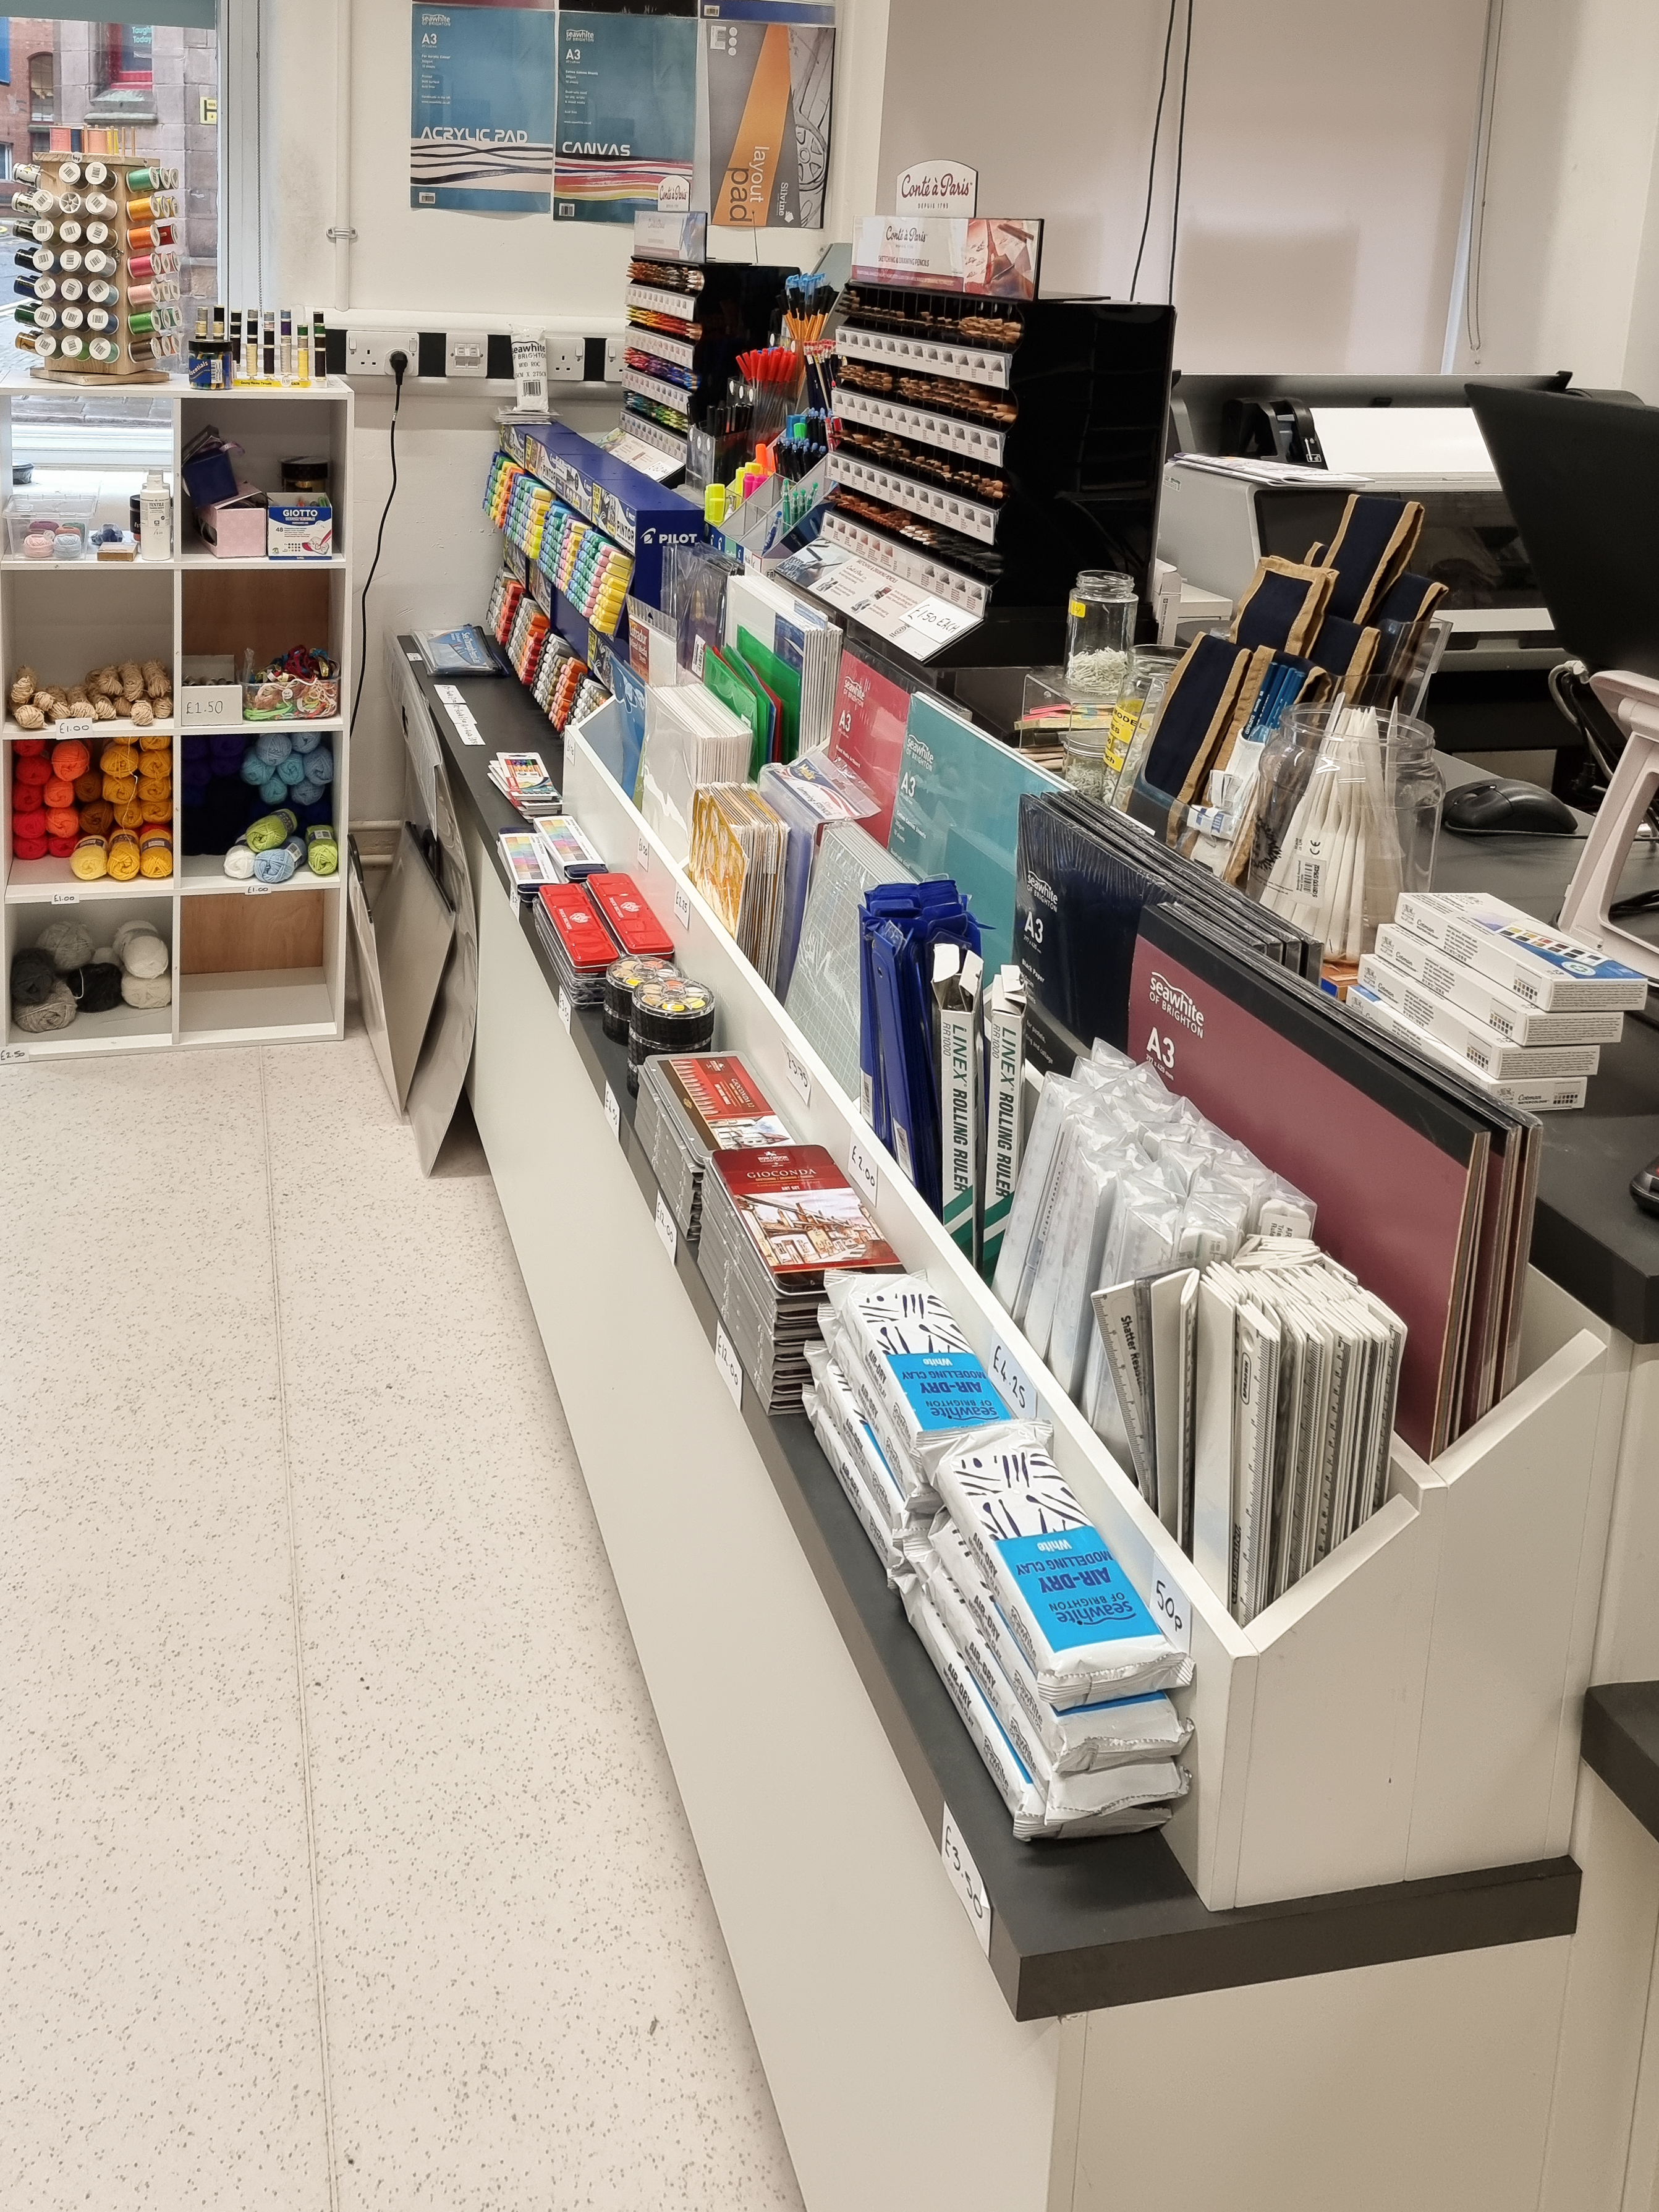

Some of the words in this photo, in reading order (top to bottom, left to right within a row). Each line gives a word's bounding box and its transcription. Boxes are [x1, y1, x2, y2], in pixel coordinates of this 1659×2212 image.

[422, 33, 438, 45] A3
[566, 30, 595, 39] seawhite
[566, 48, 581, 60] A3
[420, 126, 490, 142] ACRYLIC
[494, 129, 528, 143] PAD
[562, 142, 630, 156] CANVAS
[750, 146, 770, 203] layout
[901, 174, 931, 198] Conté
[932, 177, 938, 197] à
[940, 172, 970, 197] Paris
[728, 168, 753, 223] pad
[779, 182, 789, 216] Silvine
[885, 225, 904, 241] Conté
[904, 229, 909, 241] à
[909, 227, 927, 243] Paris
[878, 255, 896, 263] SKETCHING
[915, 258, 930, 267] PENCILS
[616, 520, 635, 543] PINTOR
[659, 534, 698, 544] PILOT
[936, 617, 962, 634] EACH
[844, 678, 865, 701] seawhite
[185, 700, 224, 715] £1.50
[839, 709, 852, 732] A3
[59, 721, 90, 734] £1.00
[906, 738, 934, 764] seawhite
[906, 748, 911, 756] OF
[911, 752, 933, 772] BRIGHTON
[900, 772, 916, 798] A3
[53, 894, 75, 903] £1.00
[247, 886, 269, 895] £1.00
[1027, 871, 1058, 905] seawhite
[1027, 885, 1033, 895] OF
[1033, 888, 1058, 913] BRIGHTON
[1024, 911, 1044, 944] A3
[1022, 958, 1033, 974] Black
[1032, 968, 1045, 984] Paper
[1395, 951, 1413, 966] Cotman
[1150, 971, 1205, 1027] seawhite
[1377, 982, 1394, 998] Cotman
[1149, 991, 1160, 1005] OF
[1161, 999, 1204, 1040] BRIGHTON
[943, 1021, 951, 1057] RR1000
[992, 1023, 1001, 1060] RR1000
[1146, 1026, 1175, 1069] A3
[953, 1023, 968, 1084] LINEX
[1000, 1026, 1017, 1088] LINEX
[1517, 1093, 1542, 1101] Cotman
[953, 1088, 968, 1146] ROLLING
[997, 1091, 1015, 1151] ROLLING
[747, 1168, 817, 1178] GIOCONDA
[851, 1144, 876, 1188] £2.00
[953, 1147, 969, 1193] RULER
[995, 1152, 1012, 1199] RULER
[656, 1199, 674, 1245] £12.00
[716, 1334, 739, 1387] £12.00
[868, 1349, 887, 1384] AIR-DRY
[922, 1358, 953, 1367] White
[1121, 1315, 1137, 1353] Shatter
[1130, 1352, 1143, 1396] Resist
[902, 1371, 927, 1380] CLAY
[919, 1381, 983, 1393] AIR-DRY
[928, 1370, 986, 1379] MODELLING
[993, 1345, 1026, 1409] £4.25
[860, 1383, 878, 1419] AIR-DRY
[930, 1406, 998, 1420] seawhite
[972, 1532, 998, 1578] AIR-DRY
[1037, 1539, 1073, 1552] White
[1016, 1561, 1046, 1576] CLAY
[1046, 1551, 1114, 1571] MODELLING
[1038, 1567, 1112, 1594] AIR-DRY
[1048, 1595, 1108, 1612] BRIGHTON
[1111, 1592, 1126, 1602] OF
[1155, 1579, 1184, 1632] 50p
[973, 1594, 1001, 1642] AIR-DRY
[1055, 1600, 1136, 1626] seawhite
[969, 1641, 997, 1690] AIR-DRY
[948, 1662, 972, 1709] AIR-DRY
[986, 1686, 999, 1708] CLAY
[962, 1707, 975, 1729] CLAY
[944, 1823, 984, 1921] £3.50
